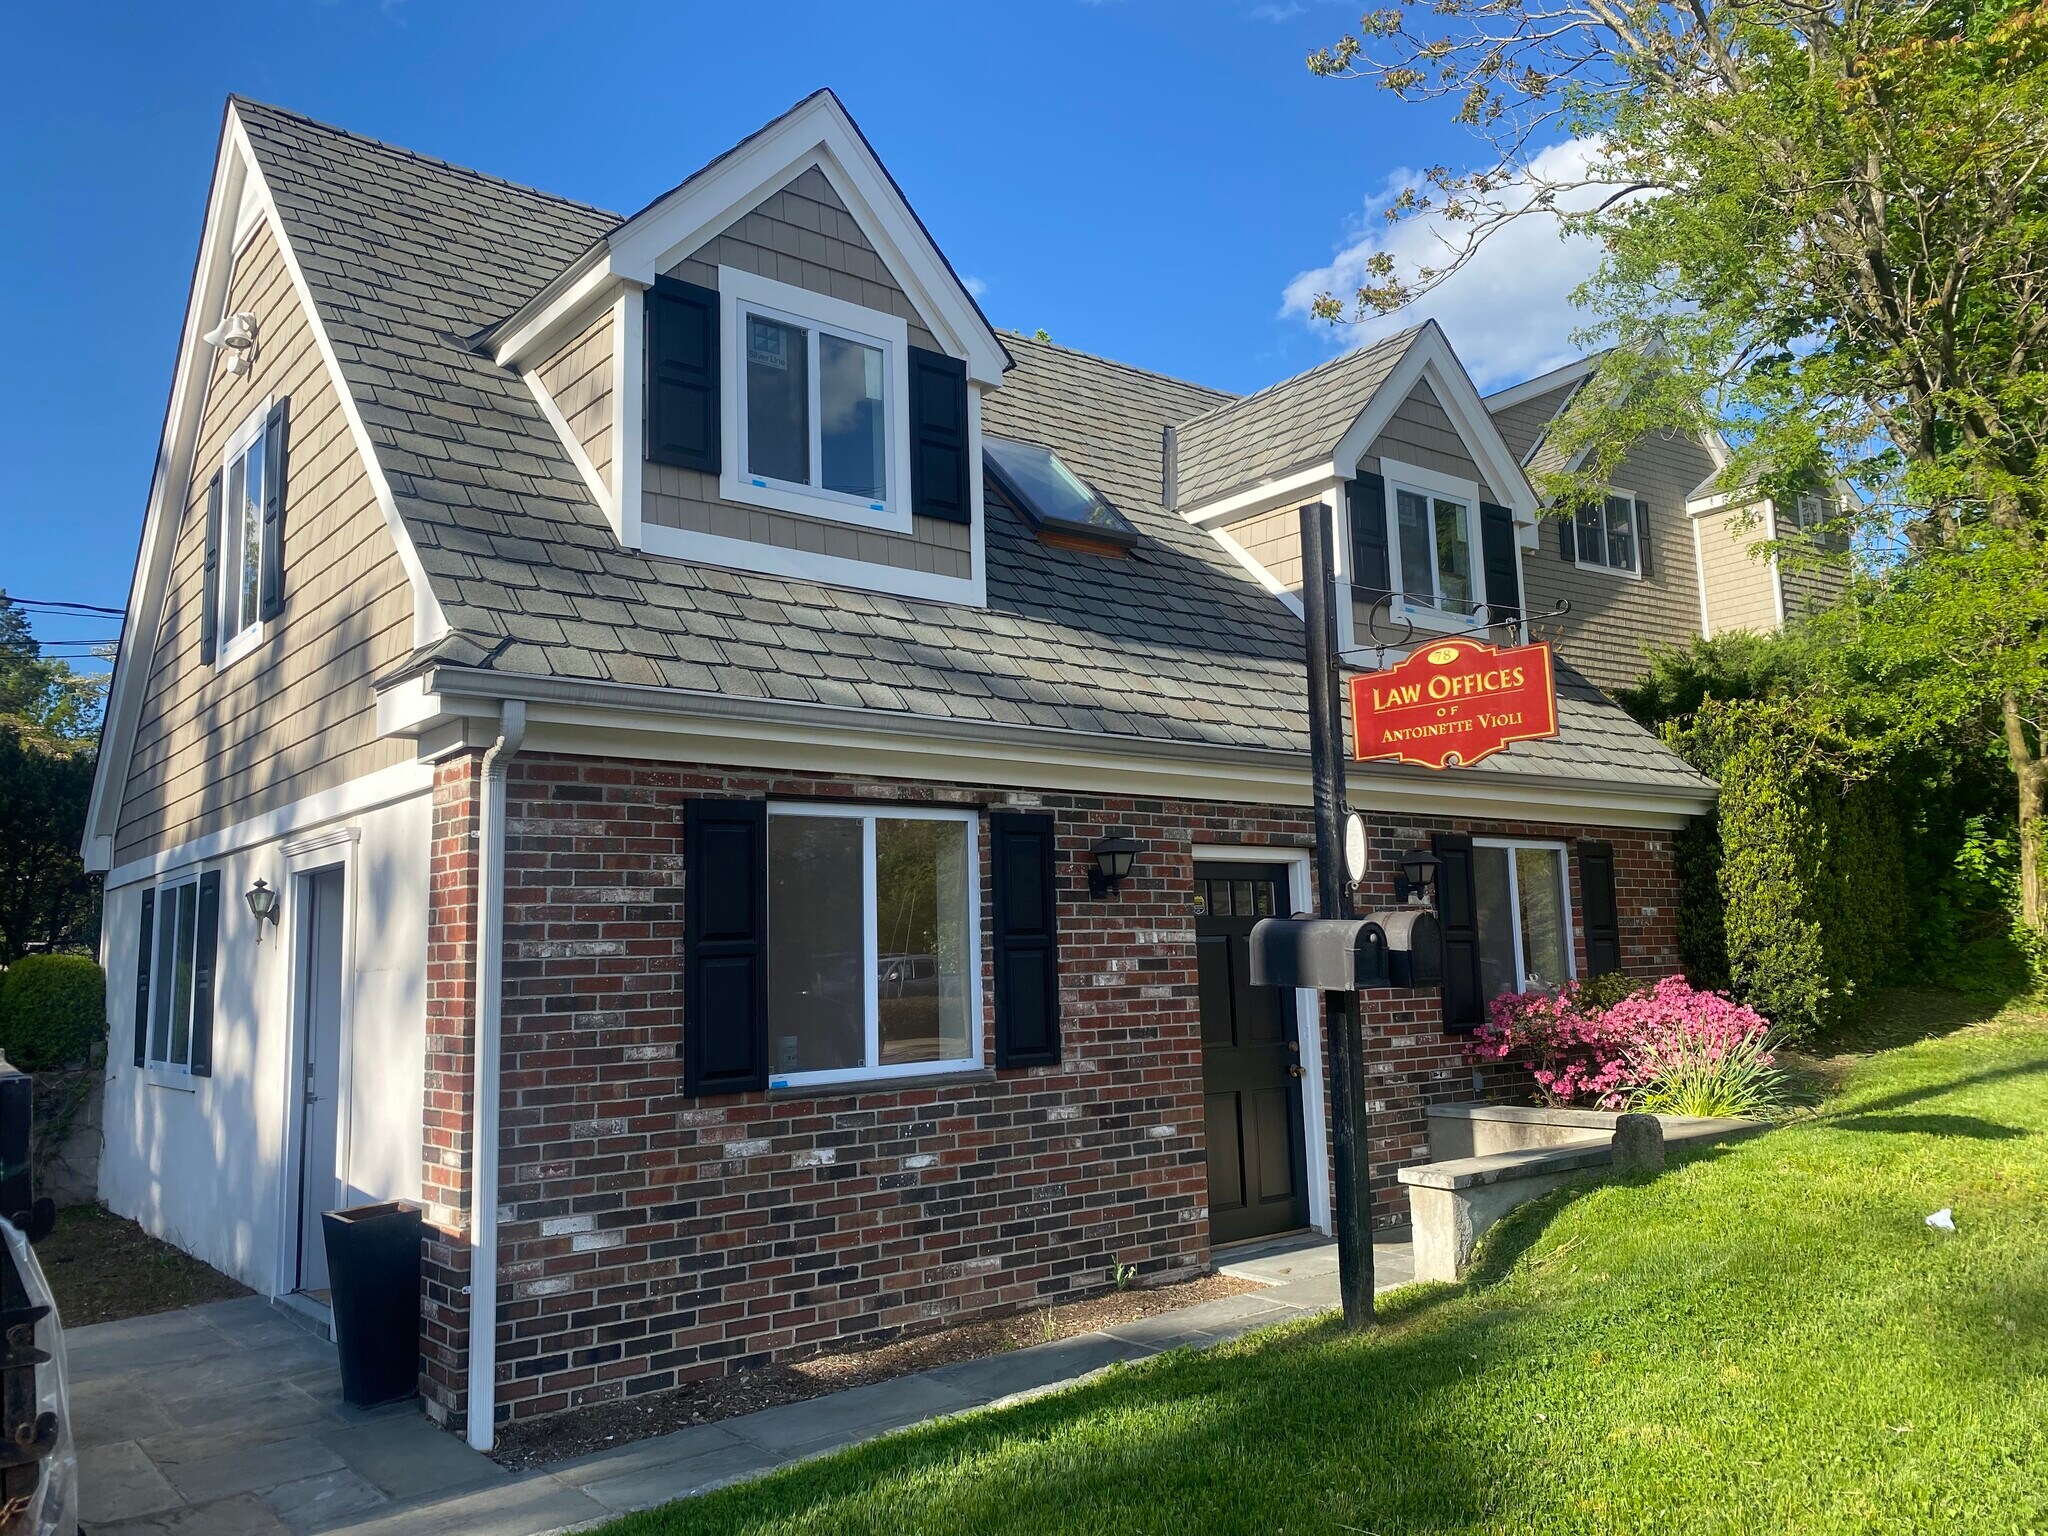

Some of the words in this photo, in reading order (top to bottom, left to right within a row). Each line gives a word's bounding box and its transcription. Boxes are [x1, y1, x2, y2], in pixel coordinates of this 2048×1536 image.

[1435, 650, 1451, 663] 78
[1373, 683, 1421, 712] LAW
[1428, 667, 1525, 700] OFFICES
[1436, 705, 1459, 717] OF
[1381, 719, 1473, 744] ANTOINETTE
[1477, 712, 1523, 729] VIOLI
